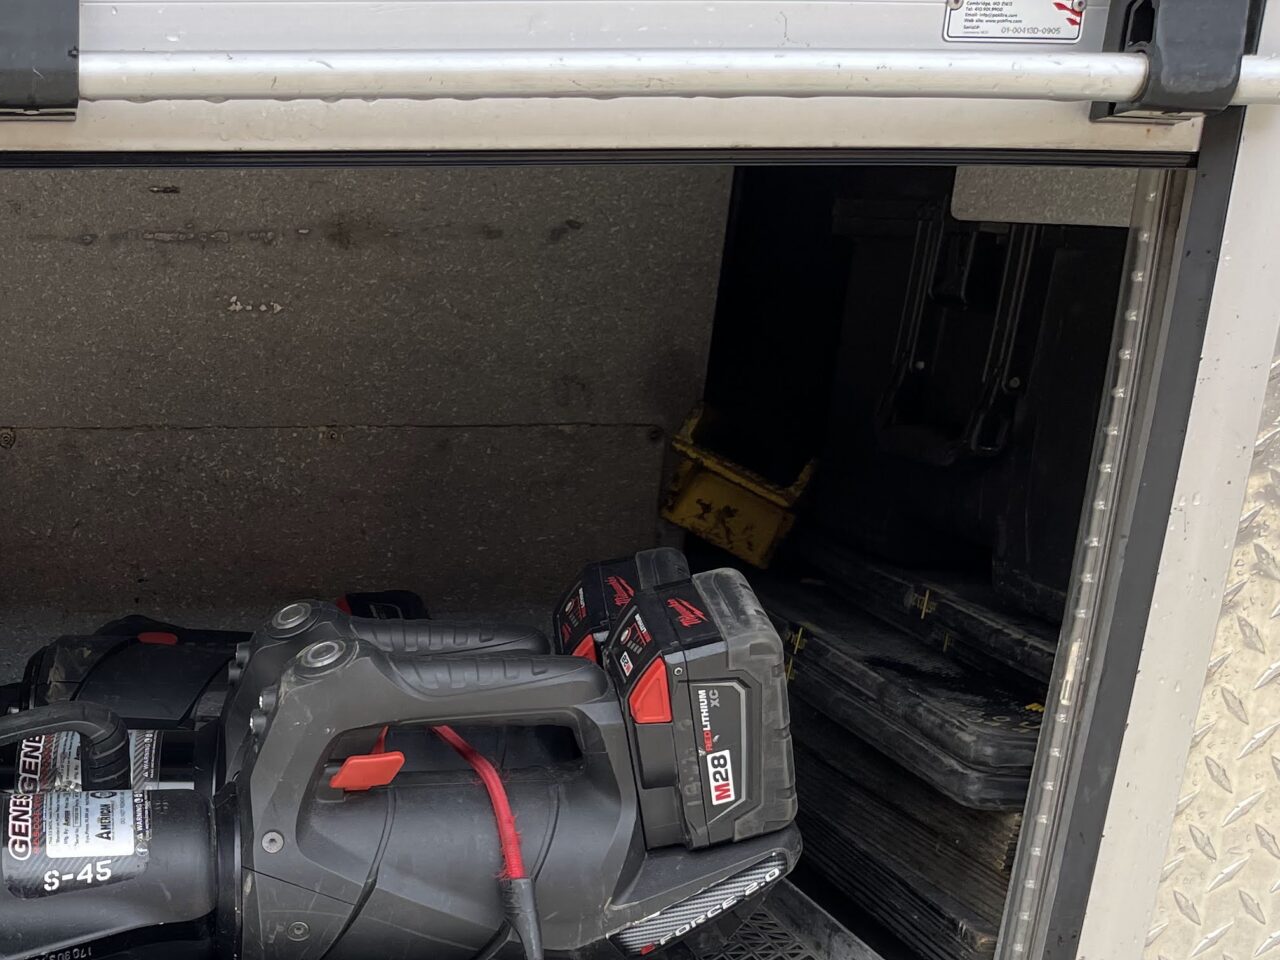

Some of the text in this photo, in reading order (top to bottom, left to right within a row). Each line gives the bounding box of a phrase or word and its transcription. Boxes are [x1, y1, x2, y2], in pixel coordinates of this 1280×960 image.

[709, 689, 720, 708] XC
[698, 689, 713, 752] REDLITHIUM
[710, 754, 731, 801] M28
[95, 803, 112, 840] AMERICAN
[43, 859, 112, 891] S-45
[744, 867, 780, 896] 2.0
